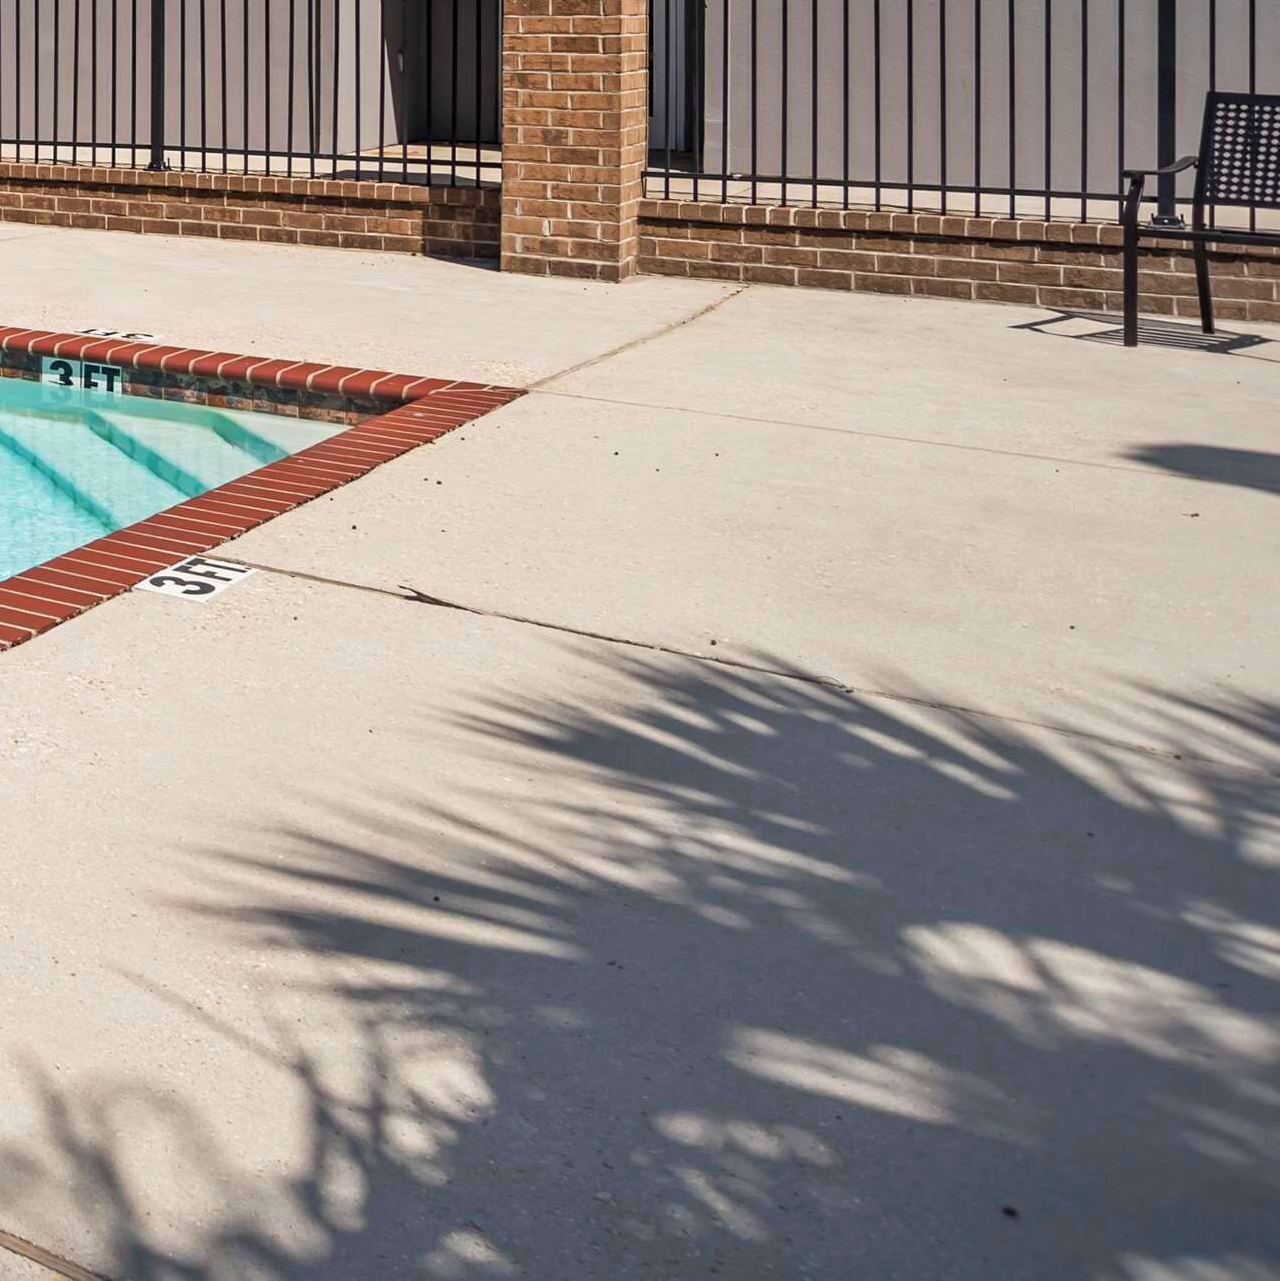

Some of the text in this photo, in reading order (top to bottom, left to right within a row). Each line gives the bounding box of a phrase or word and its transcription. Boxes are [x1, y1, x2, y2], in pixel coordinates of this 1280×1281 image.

[49, 360, 121, 392] 3 FT
[149, 576, 216, 595] 3
